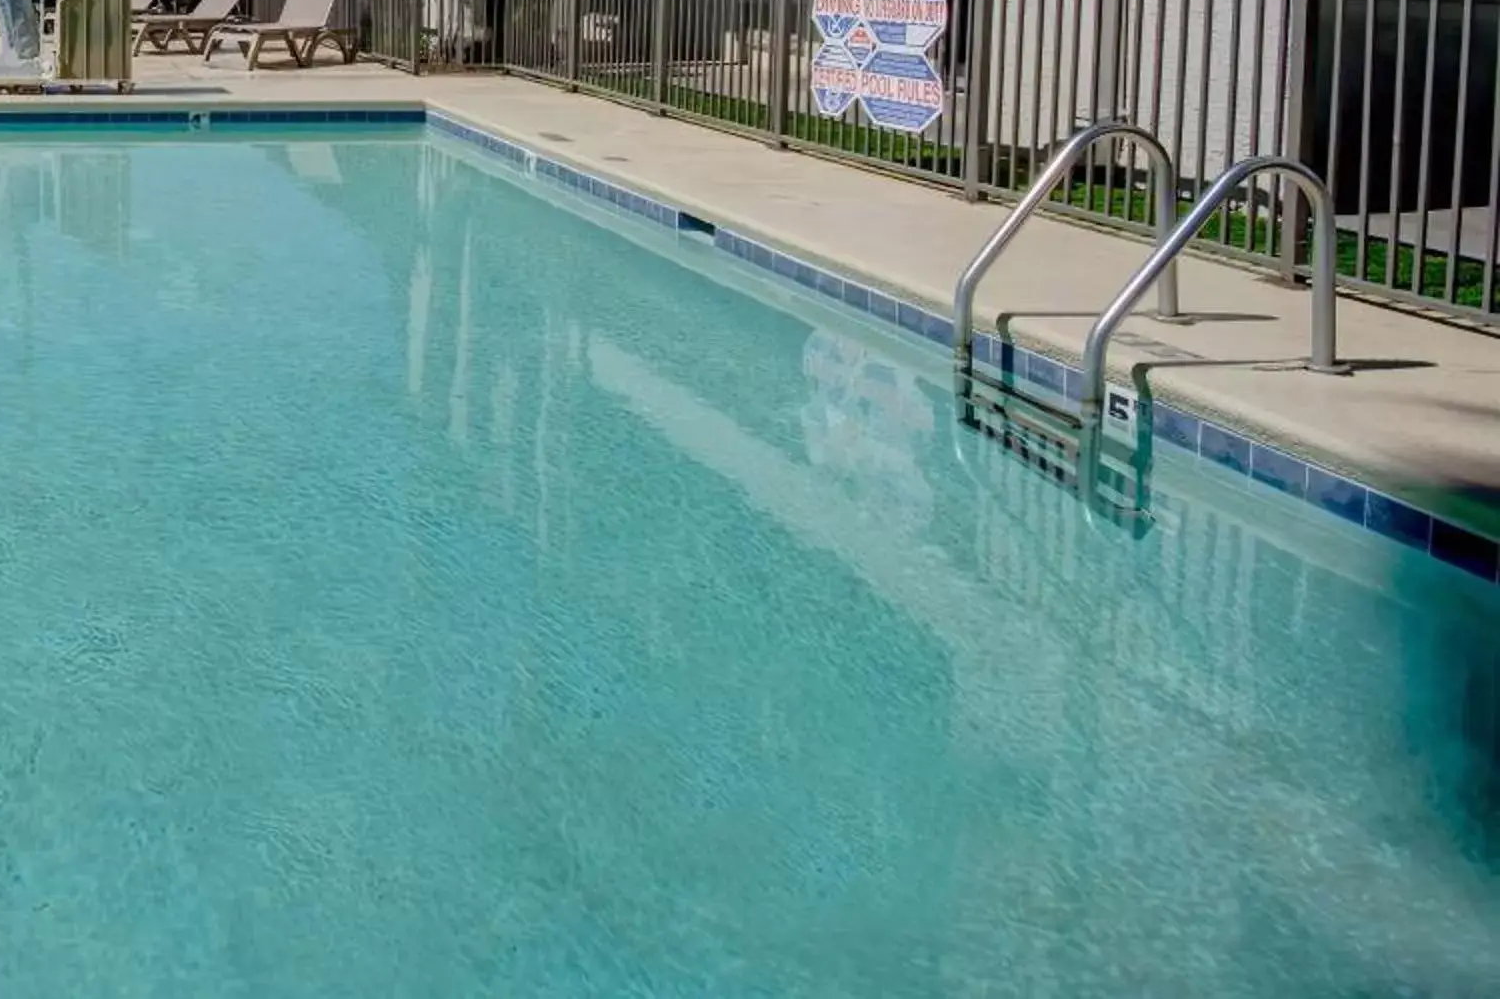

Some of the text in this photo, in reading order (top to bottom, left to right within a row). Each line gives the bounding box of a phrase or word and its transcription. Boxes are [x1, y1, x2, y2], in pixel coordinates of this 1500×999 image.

[862, 72, 940, 106] POOL RULES
[1109, 393, 1129, 421] 5
